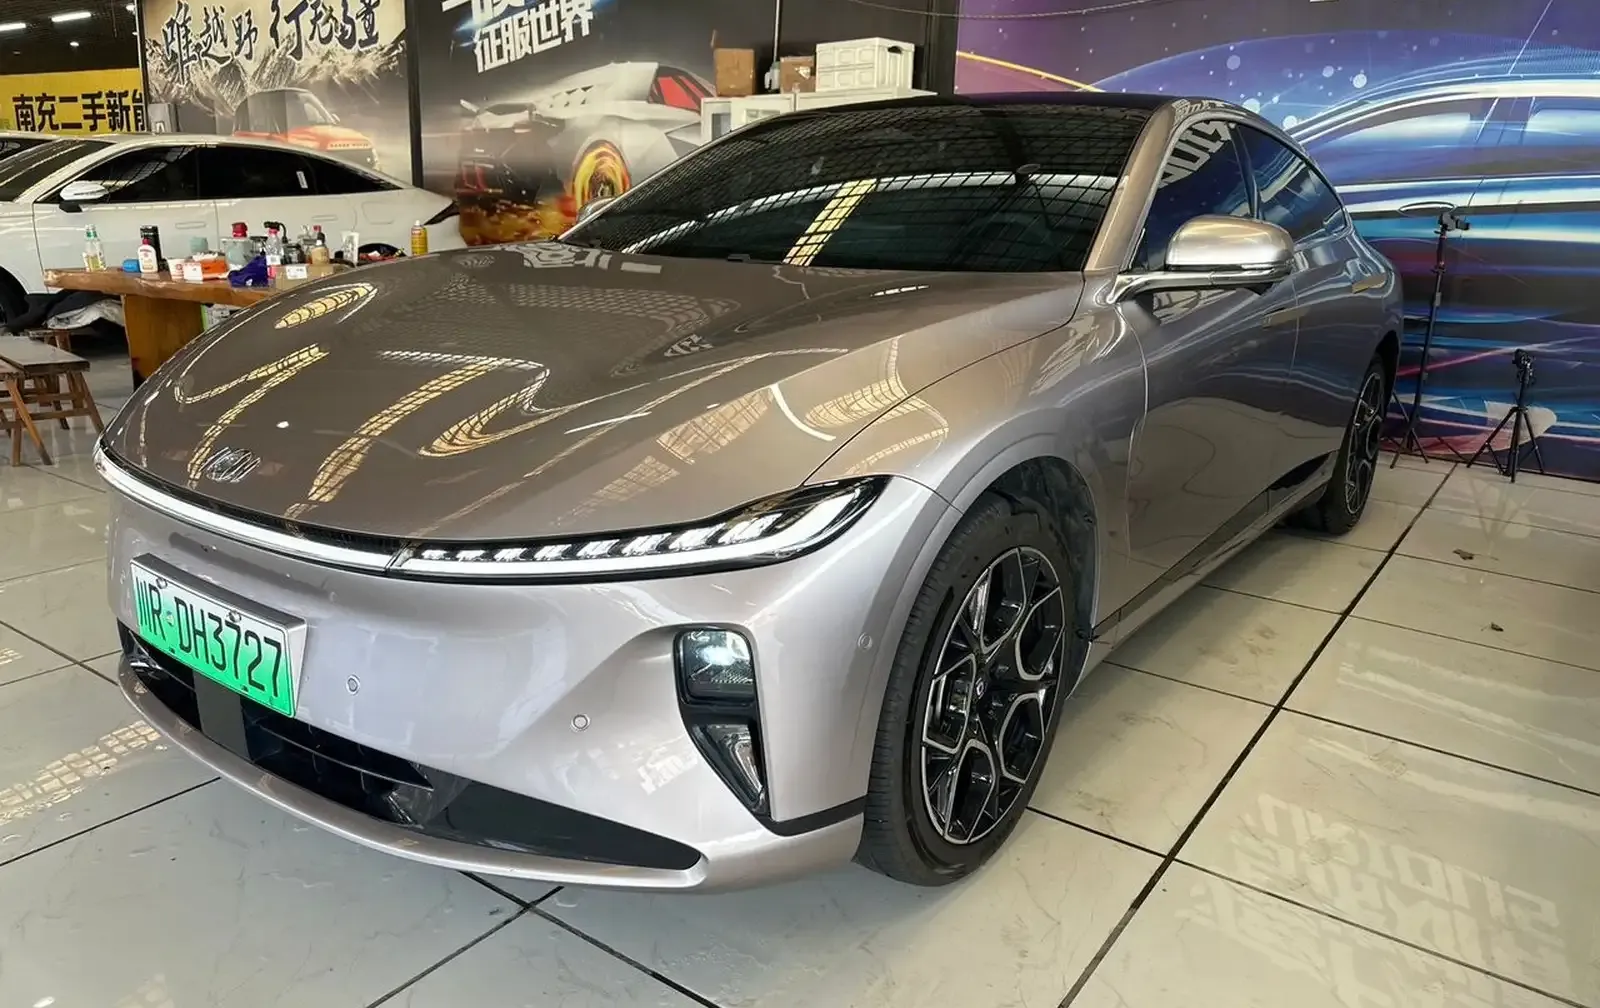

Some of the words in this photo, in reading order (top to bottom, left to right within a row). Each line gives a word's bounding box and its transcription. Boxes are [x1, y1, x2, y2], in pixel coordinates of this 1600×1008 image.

[162, 1, 258, 85] 唯越野
[473, 0, 594, 74] 征服世界
